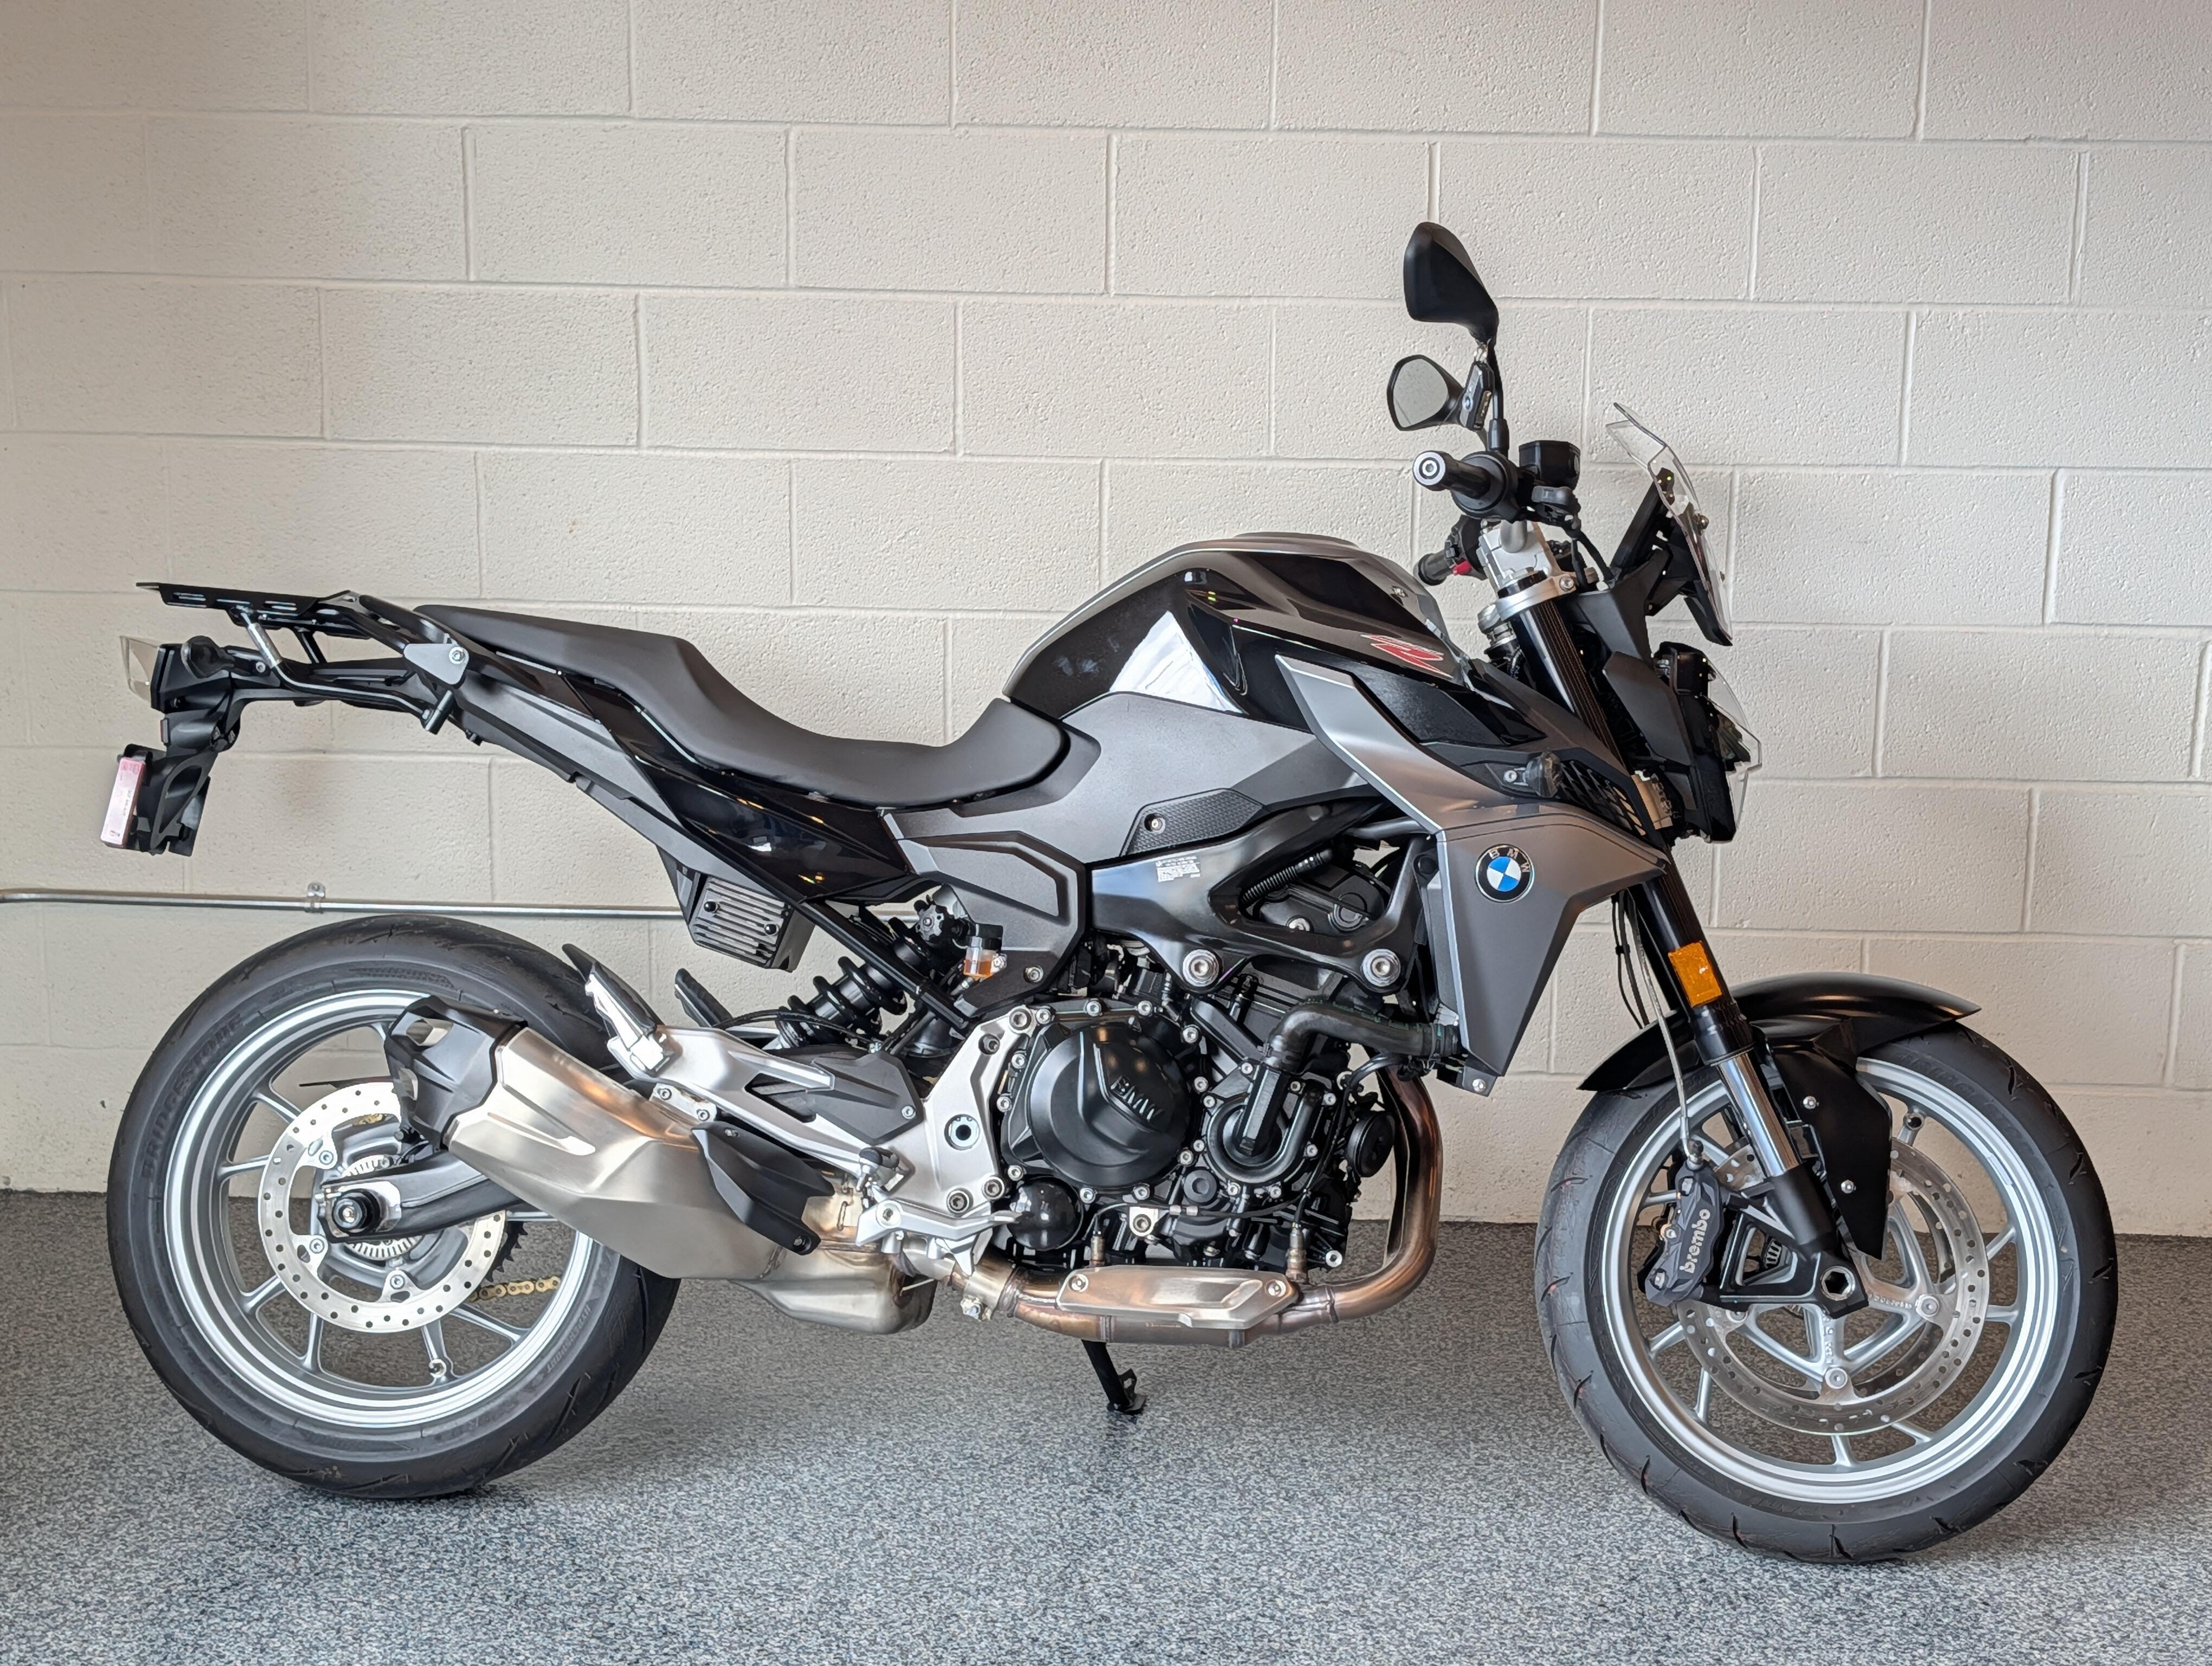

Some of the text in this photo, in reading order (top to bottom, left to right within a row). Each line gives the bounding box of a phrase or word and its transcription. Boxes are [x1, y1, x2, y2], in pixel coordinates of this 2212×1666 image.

[1488, 848, 1531, 873] BMW
[141, 1011, 243, 1180] BRIDGESTONE
[1110, 1075, 1165, 1122] BMW
[1679, 1208, 1711, 1273] brembo
